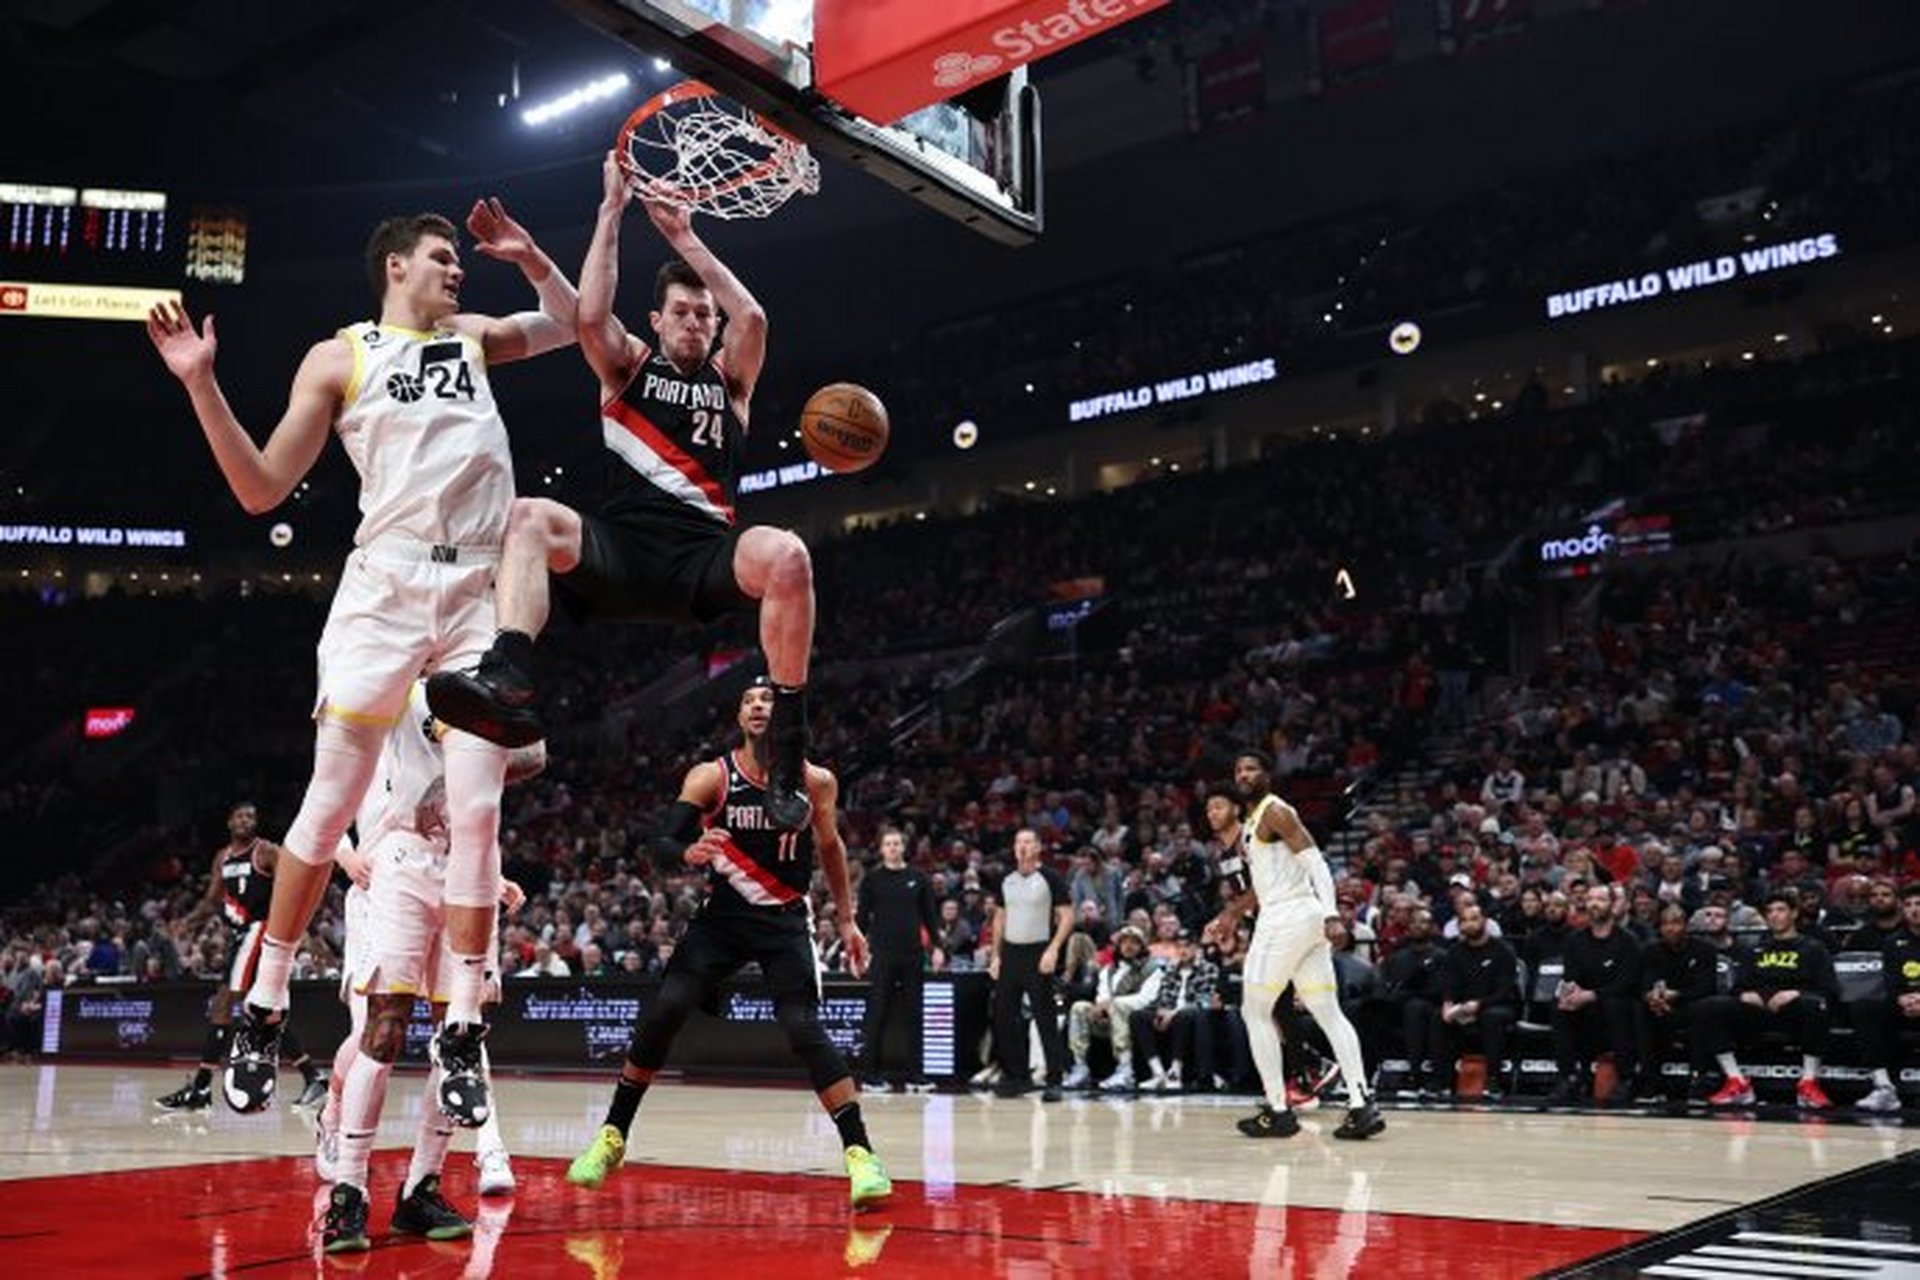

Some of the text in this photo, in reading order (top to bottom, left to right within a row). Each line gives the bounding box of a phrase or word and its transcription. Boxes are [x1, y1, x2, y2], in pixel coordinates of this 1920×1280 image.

[992, 0, 1127, 60] State
[1547, 233, 1838, 318] BUFFALO WILD WINGS
[426, 361, 475, 400] 24
[1069, 358, 1276, 421] BUFFALO WILD WINGS
[692, 410, 723, 448] 24
[779, 461, 818, 485] WILD
[76, 527, 123, 544] WILD
[126, 528, 185, 546] WINGS
[779, 830, 798, 861] 11
[1757, 952, 1799, 968] JAZZ
